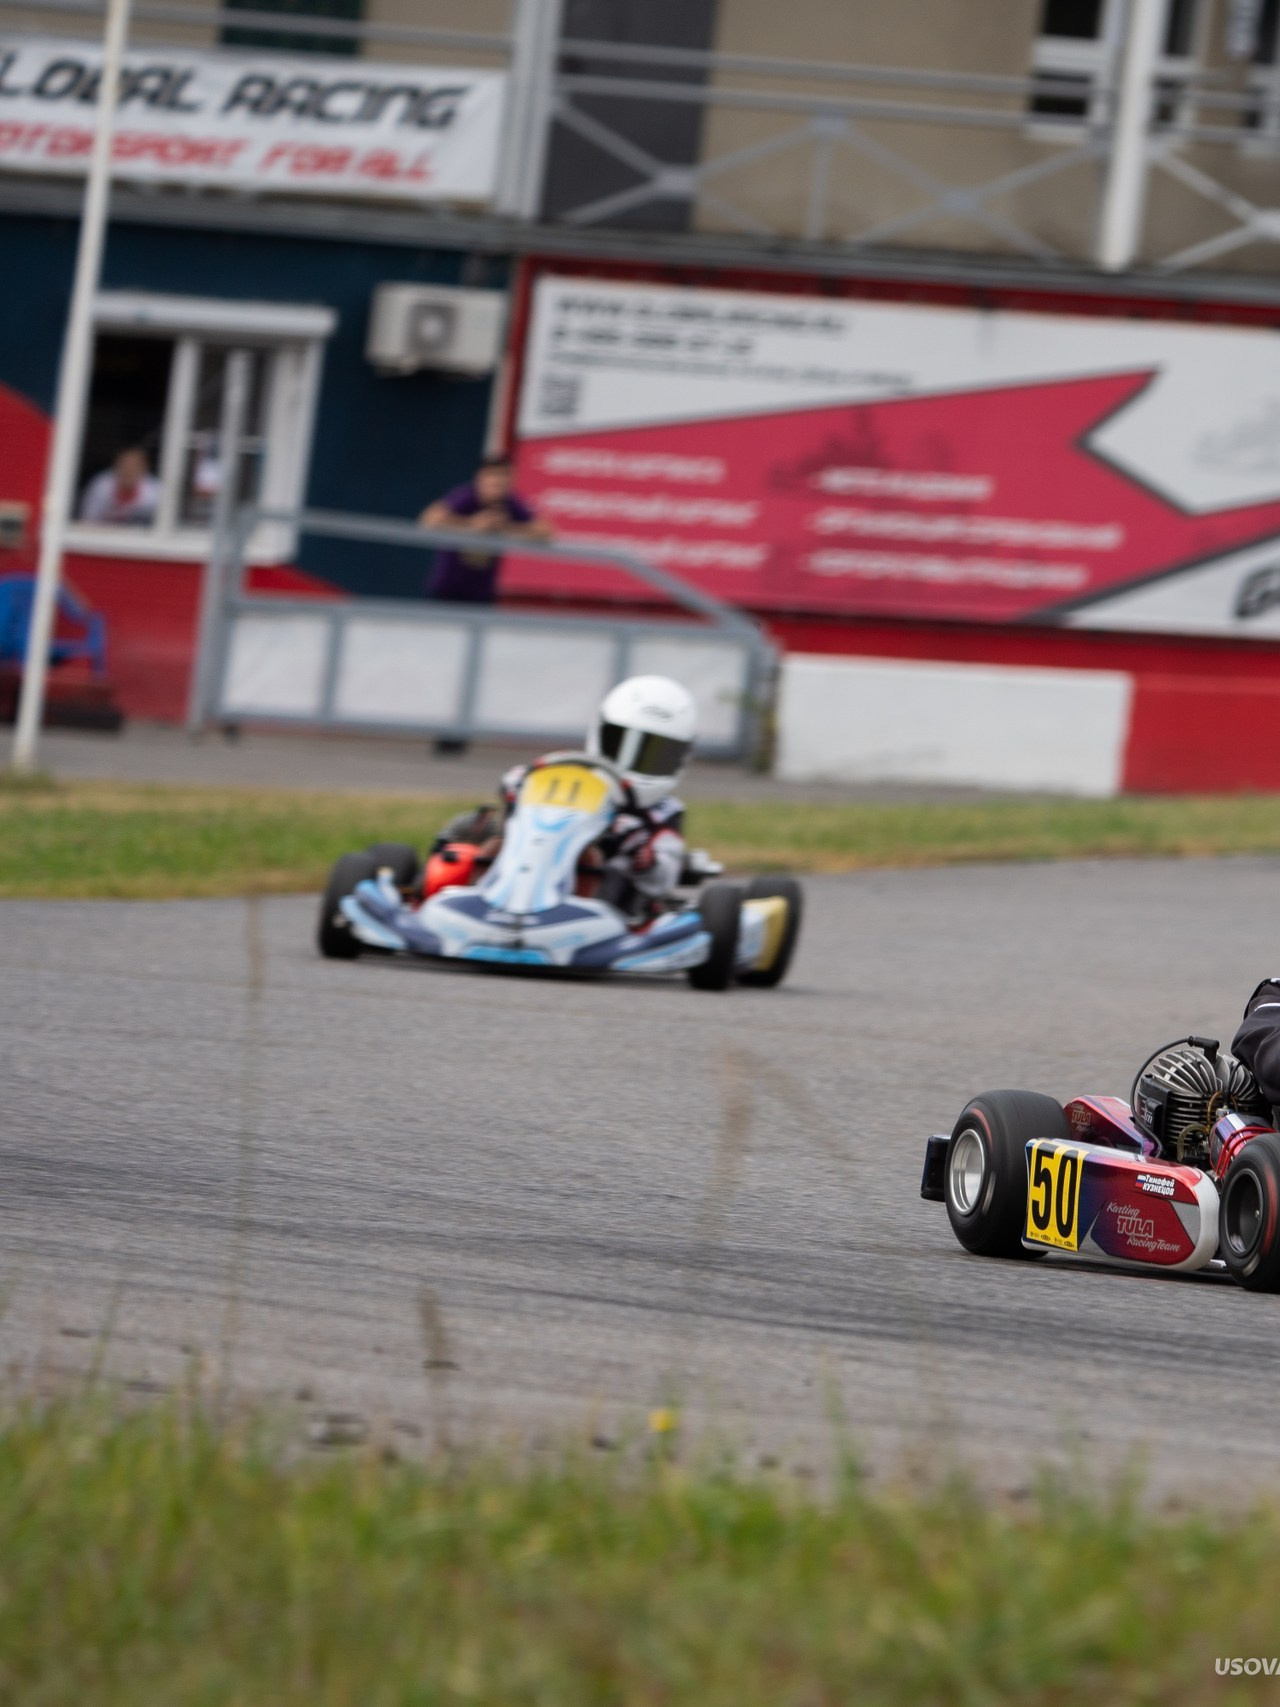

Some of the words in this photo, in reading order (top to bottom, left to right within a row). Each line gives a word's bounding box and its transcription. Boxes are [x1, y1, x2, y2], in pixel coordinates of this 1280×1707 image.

[218, 73, 474, 130] RACING
[544, 777, 582, 806] 11
[1032, 1143, 1080, 1239] 50
[1142, 1182, 1175, 1196] КУЗНЕЦОВ
[1145, 1175, 1175, 1187] Тимофей
[1106, 1201, 1140, 1217] Karting
[1117, 1215, 1154, 1238] TULA
